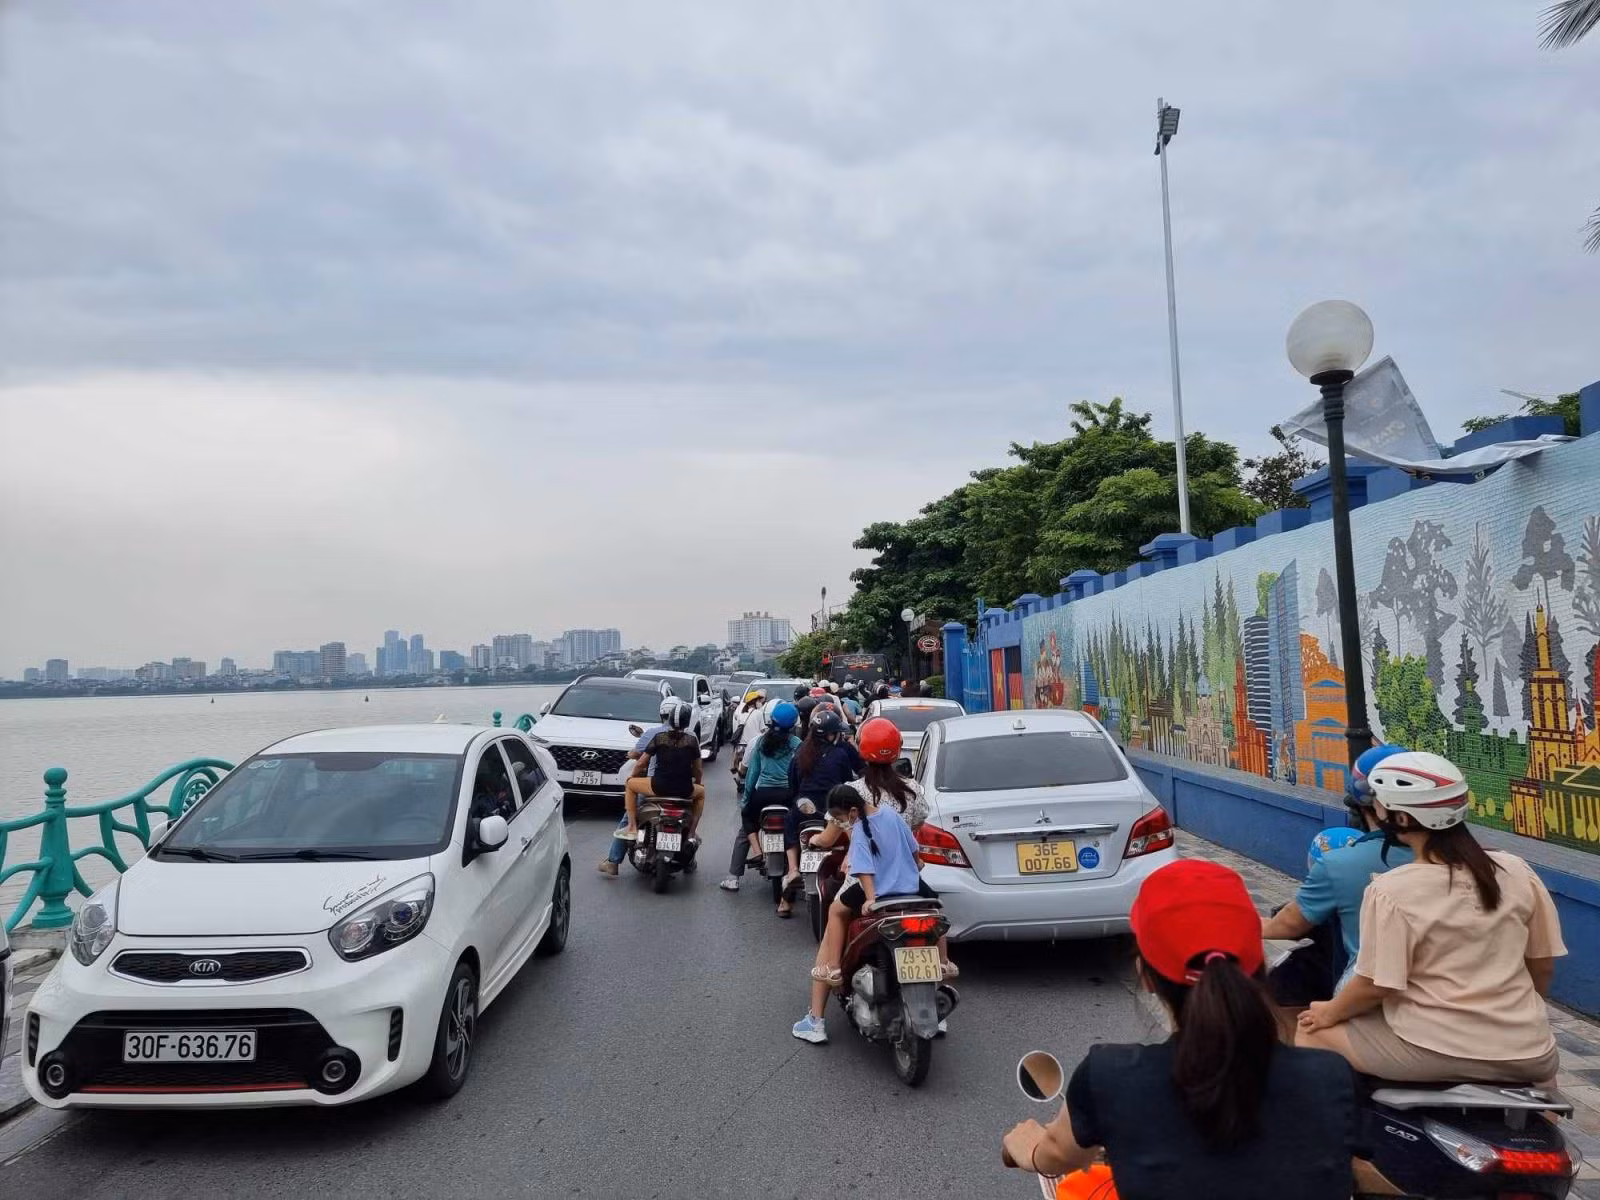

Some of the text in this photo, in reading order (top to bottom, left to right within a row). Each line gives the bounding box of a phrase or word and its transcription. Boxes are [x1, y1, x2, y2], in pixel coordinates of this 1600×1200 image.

[1033, 844, 1059, 856] 36E
[1025, 857, 1072, 871] 007.66
[902, 950, 933, 964] 29-S1
[194, 962, 215, 972] KIA
[900, 965, 939, 980] 602.61
[127, 1034, 252, 1059] 30F-636.76
